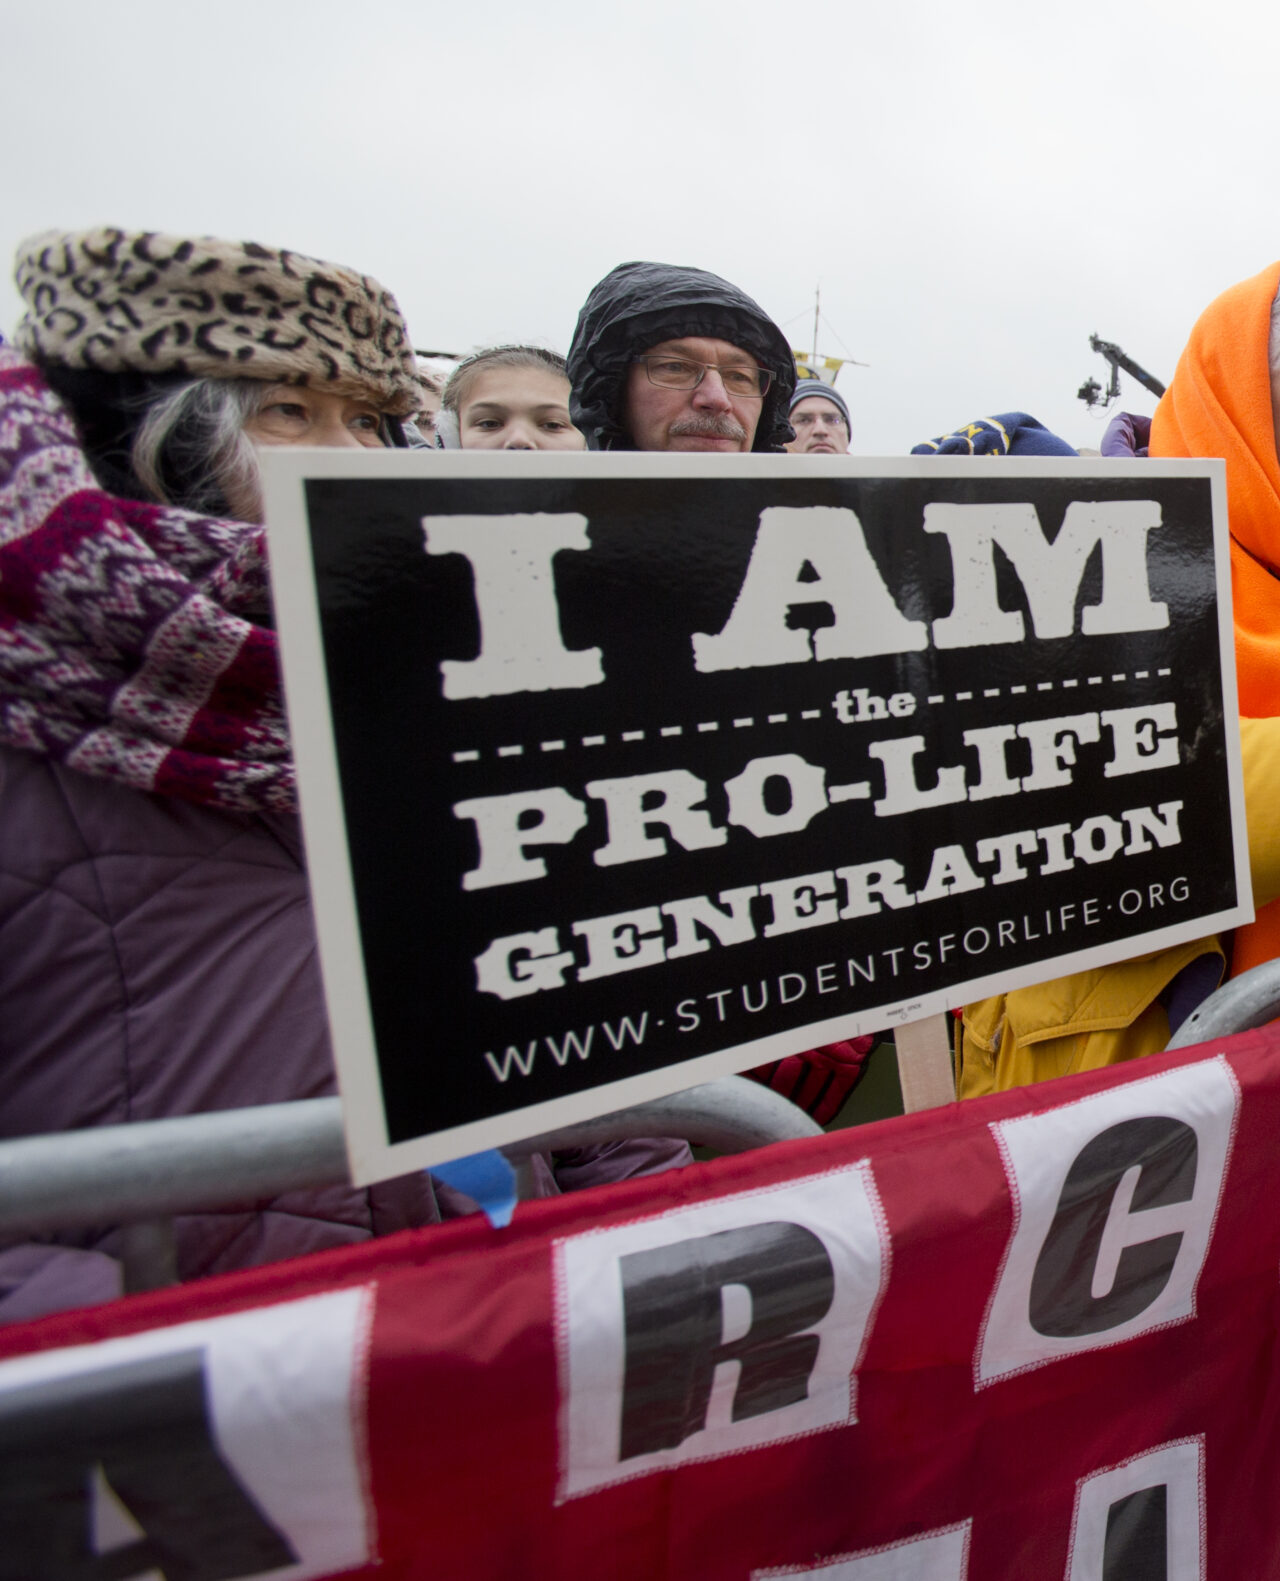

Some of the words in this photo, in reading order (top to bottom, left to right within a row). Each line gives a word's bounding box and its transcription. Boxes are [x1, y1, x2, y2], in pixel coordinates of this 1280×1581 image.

[421, 512, 605, 700] I
[691, 499, 1172, 673] AM
[453, 702, 1181, 891] PRO-LIFE
[832, 688, 917, 724] the
[474, 800, 1184, 1000] GENERATION
